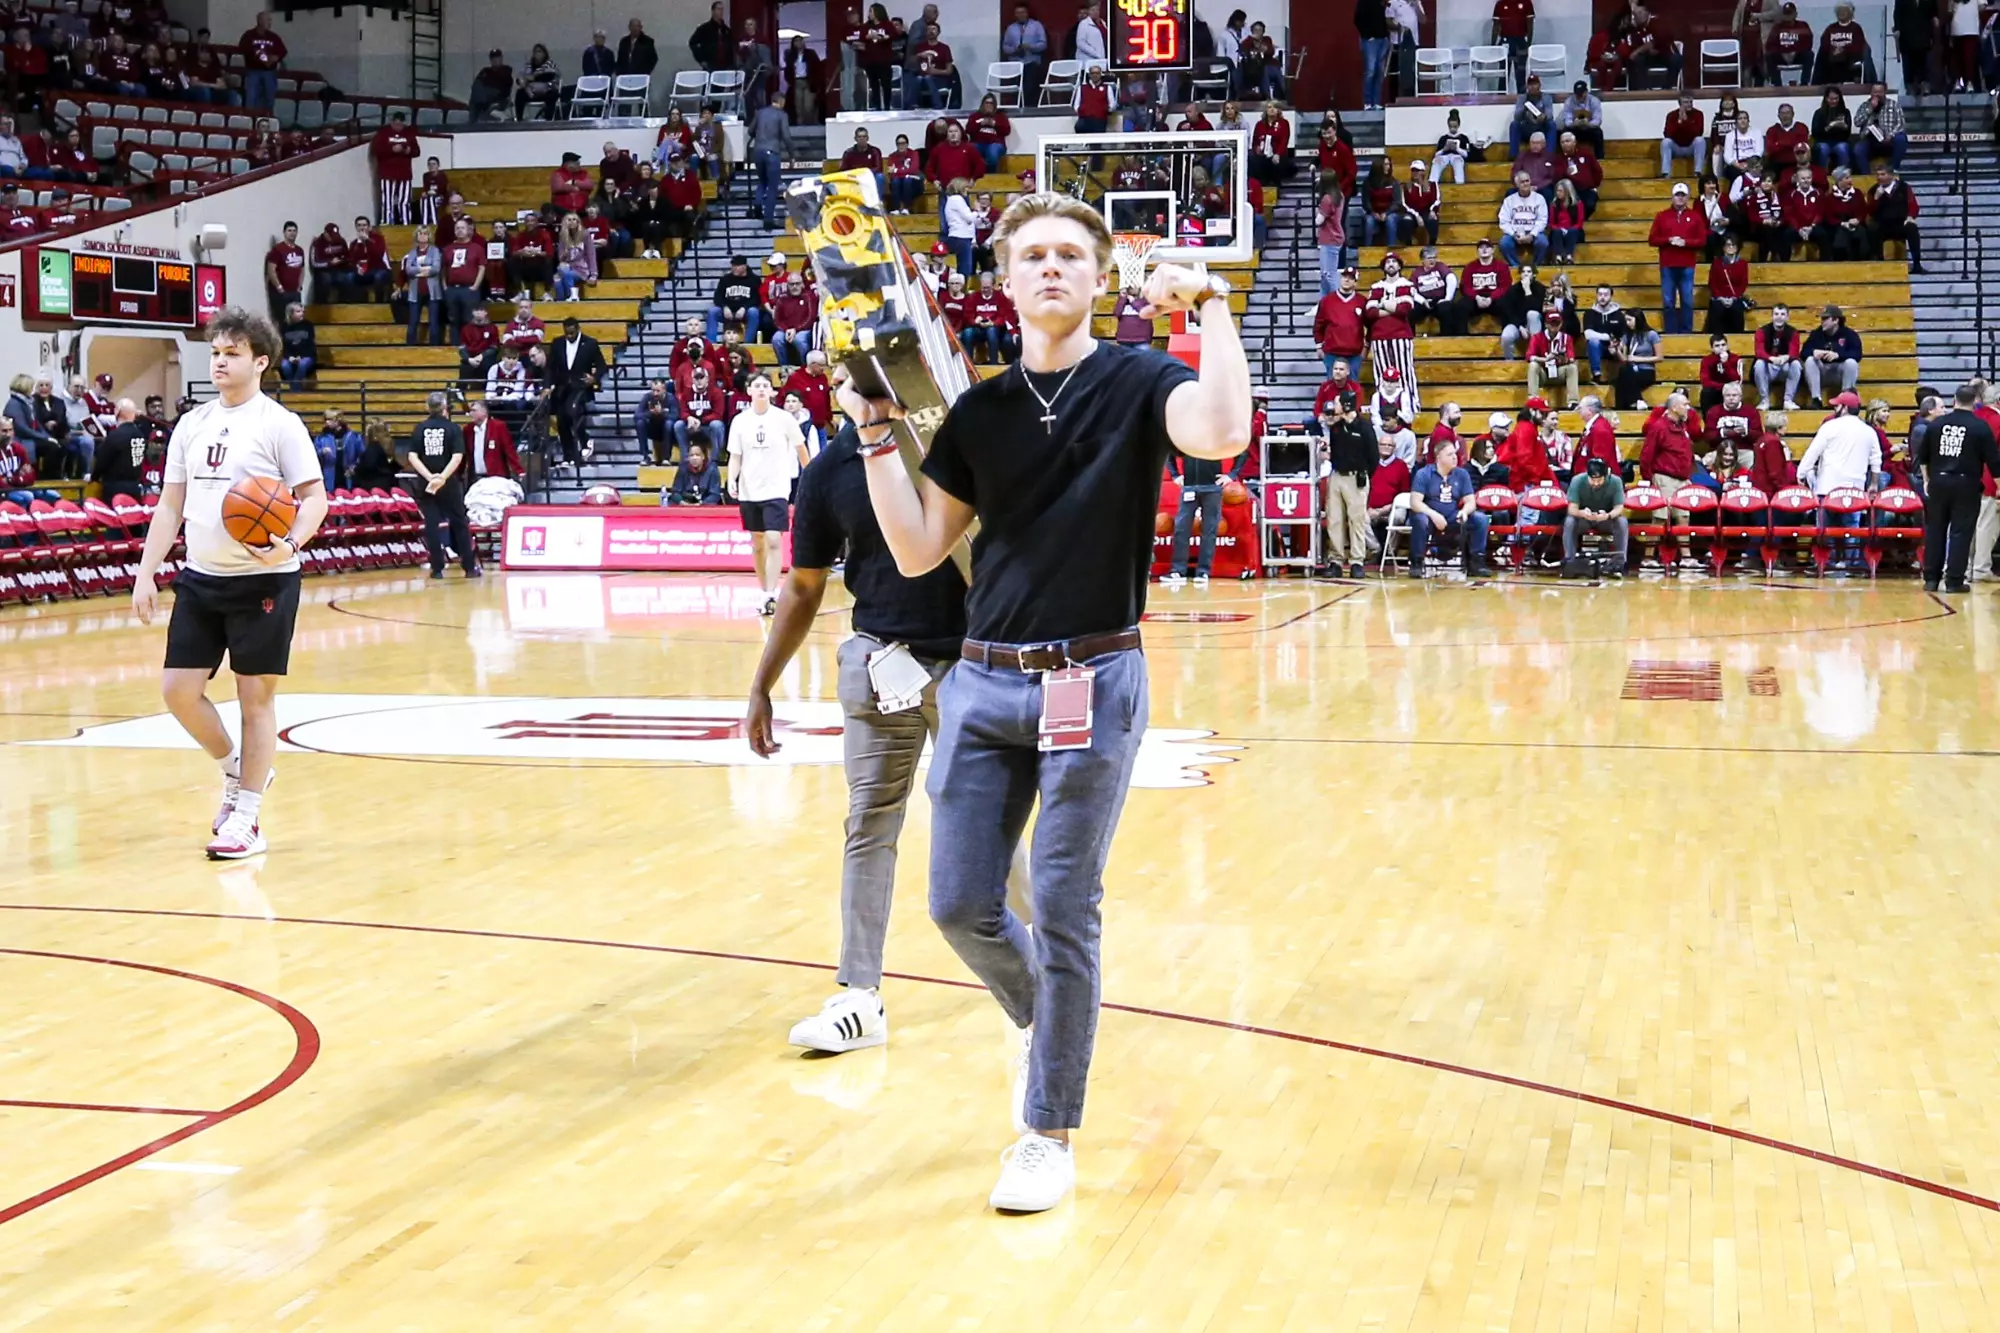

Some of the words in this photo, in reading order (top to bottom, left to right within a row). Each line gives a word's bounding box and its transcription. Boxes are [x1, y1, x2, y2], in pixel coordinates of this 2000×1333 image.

[1129, 19, 1174, 61] 30
[74, 256, 112, 274] INDIANA
[158, 265, 191, 282] PURDUE
[423, 428, 445, 438] CSC
[1942, 424, 1967, 437] CSC
[130, 438, 145, 448] CSC
[424, 437, 444, 447] EVENT
[1940, 434, 1965, 447] EVENT
[425, 446, 444, 456] STAFF
[1939, 445, 1962, 458] STAFF
[1478, 487, 1512, 498] INDIANA
[1528, 486, 1563, 498] INDIANA
[1626, 487, 1661, 498] INDIANA
[1678, 487, 1711, 498] INDIANA
[1727, 487, 1762, 498] INDIANA
[1778, 487, 1812, 498] INDIANA
[1829, 488, 1864, 499] INDIANA
[1881, 488, 1916, 499] INDIANA
[1276, 486, 1299, 515] IU
